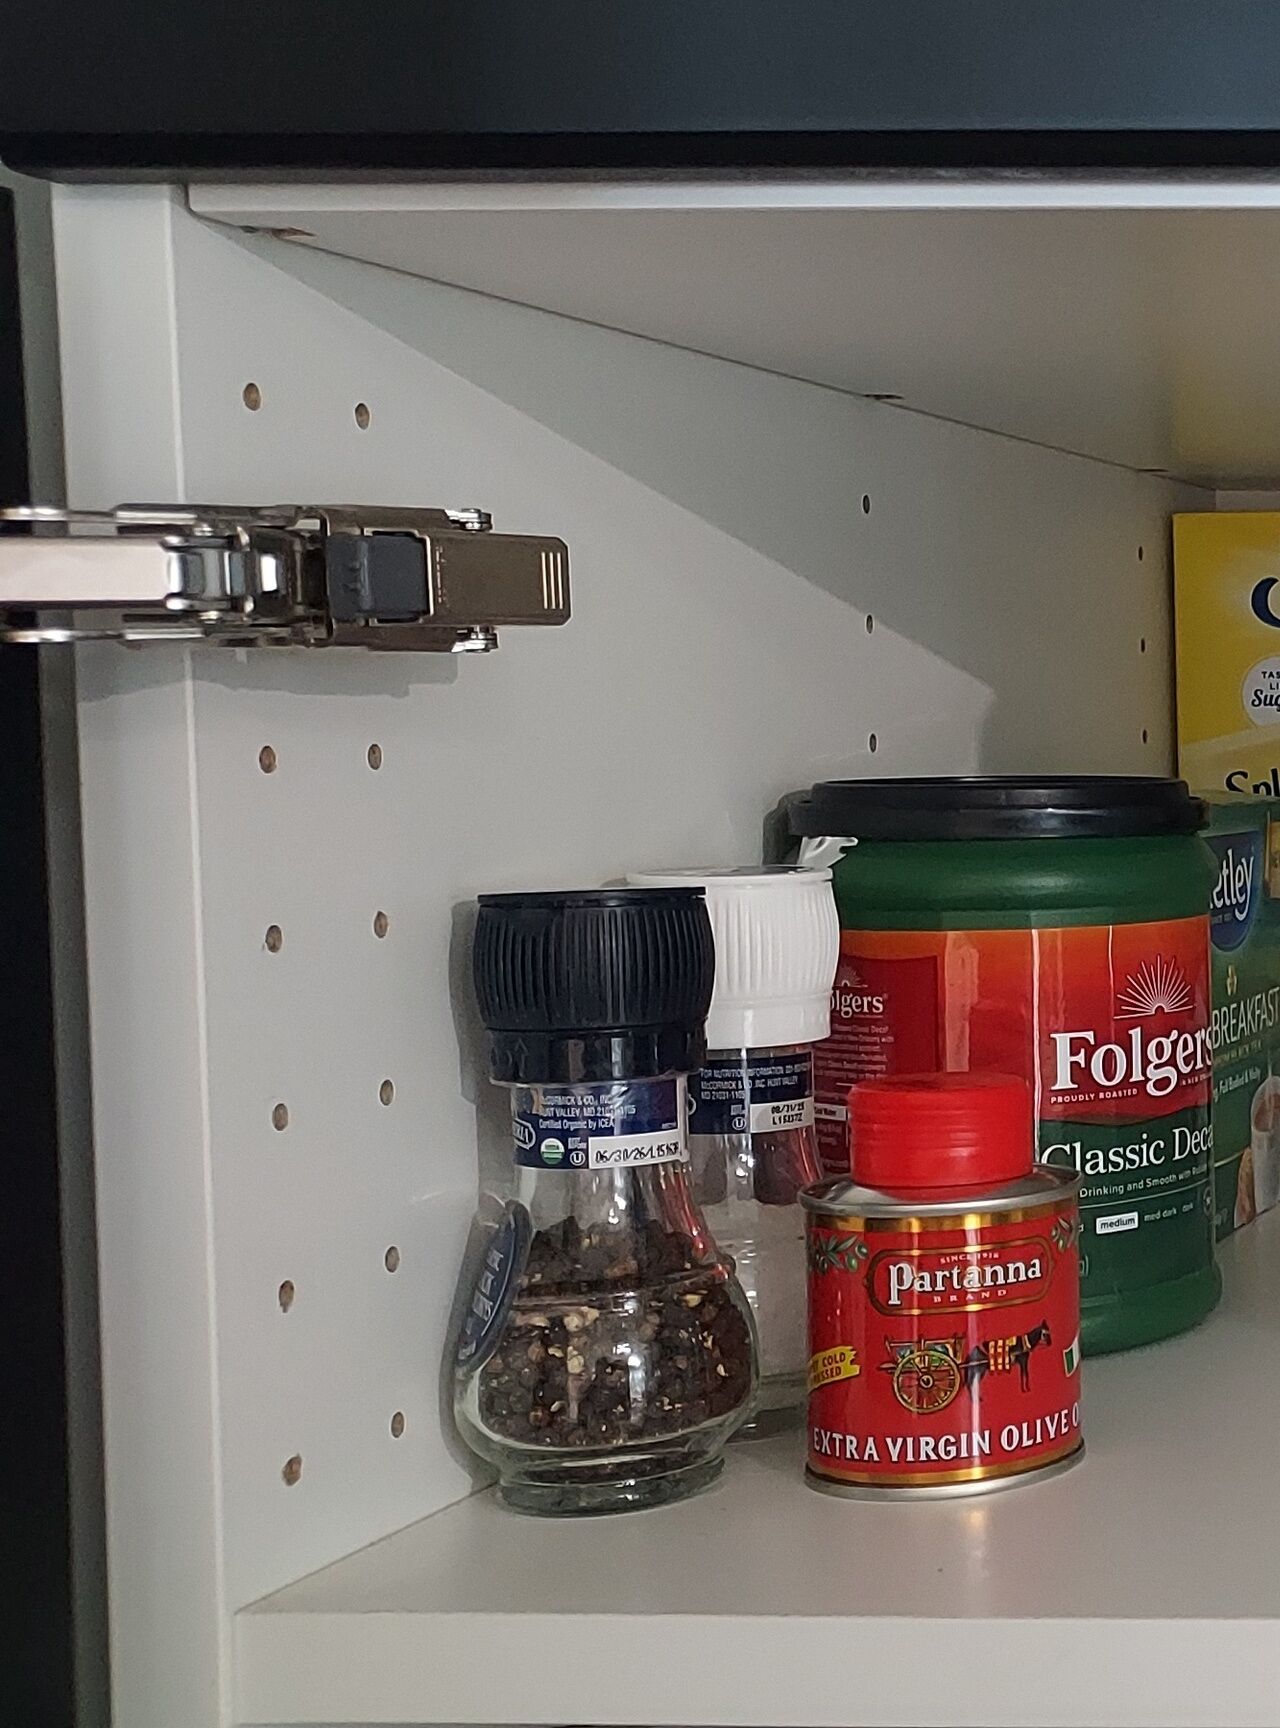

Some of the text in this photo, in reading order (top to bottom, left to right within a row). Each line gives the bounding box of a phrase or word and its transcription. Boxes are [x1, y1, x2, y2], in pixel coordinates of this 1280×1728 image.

[1212, 985, 1280, 1050] BREAKFAST
[1050, 1026, 1213, 1097] Folgers
[1051, 1088, 1137, 1104] PROUDLY ROASTED
[1041, 1125, 1213, 1175] Classic Deca
[1080, 1183, 1124, 1198] Drinking
[1127, 1180, 1144, 1191] and
[1146, 1173, 1176, 1188] Smooth
[1100, 1217, 1136, 1230] medium
[888, 1258, 1042, 1306] Partanna
[933, 1289, 1008, 1304] BRAND
[822, 1351, 846, 1368] COLD
[813, 1427, 881, 1462] EXTRA
[885, 1430, 991, 1462] VIRGIN
[1000, 1409, 1069, 1452] OLIVE
